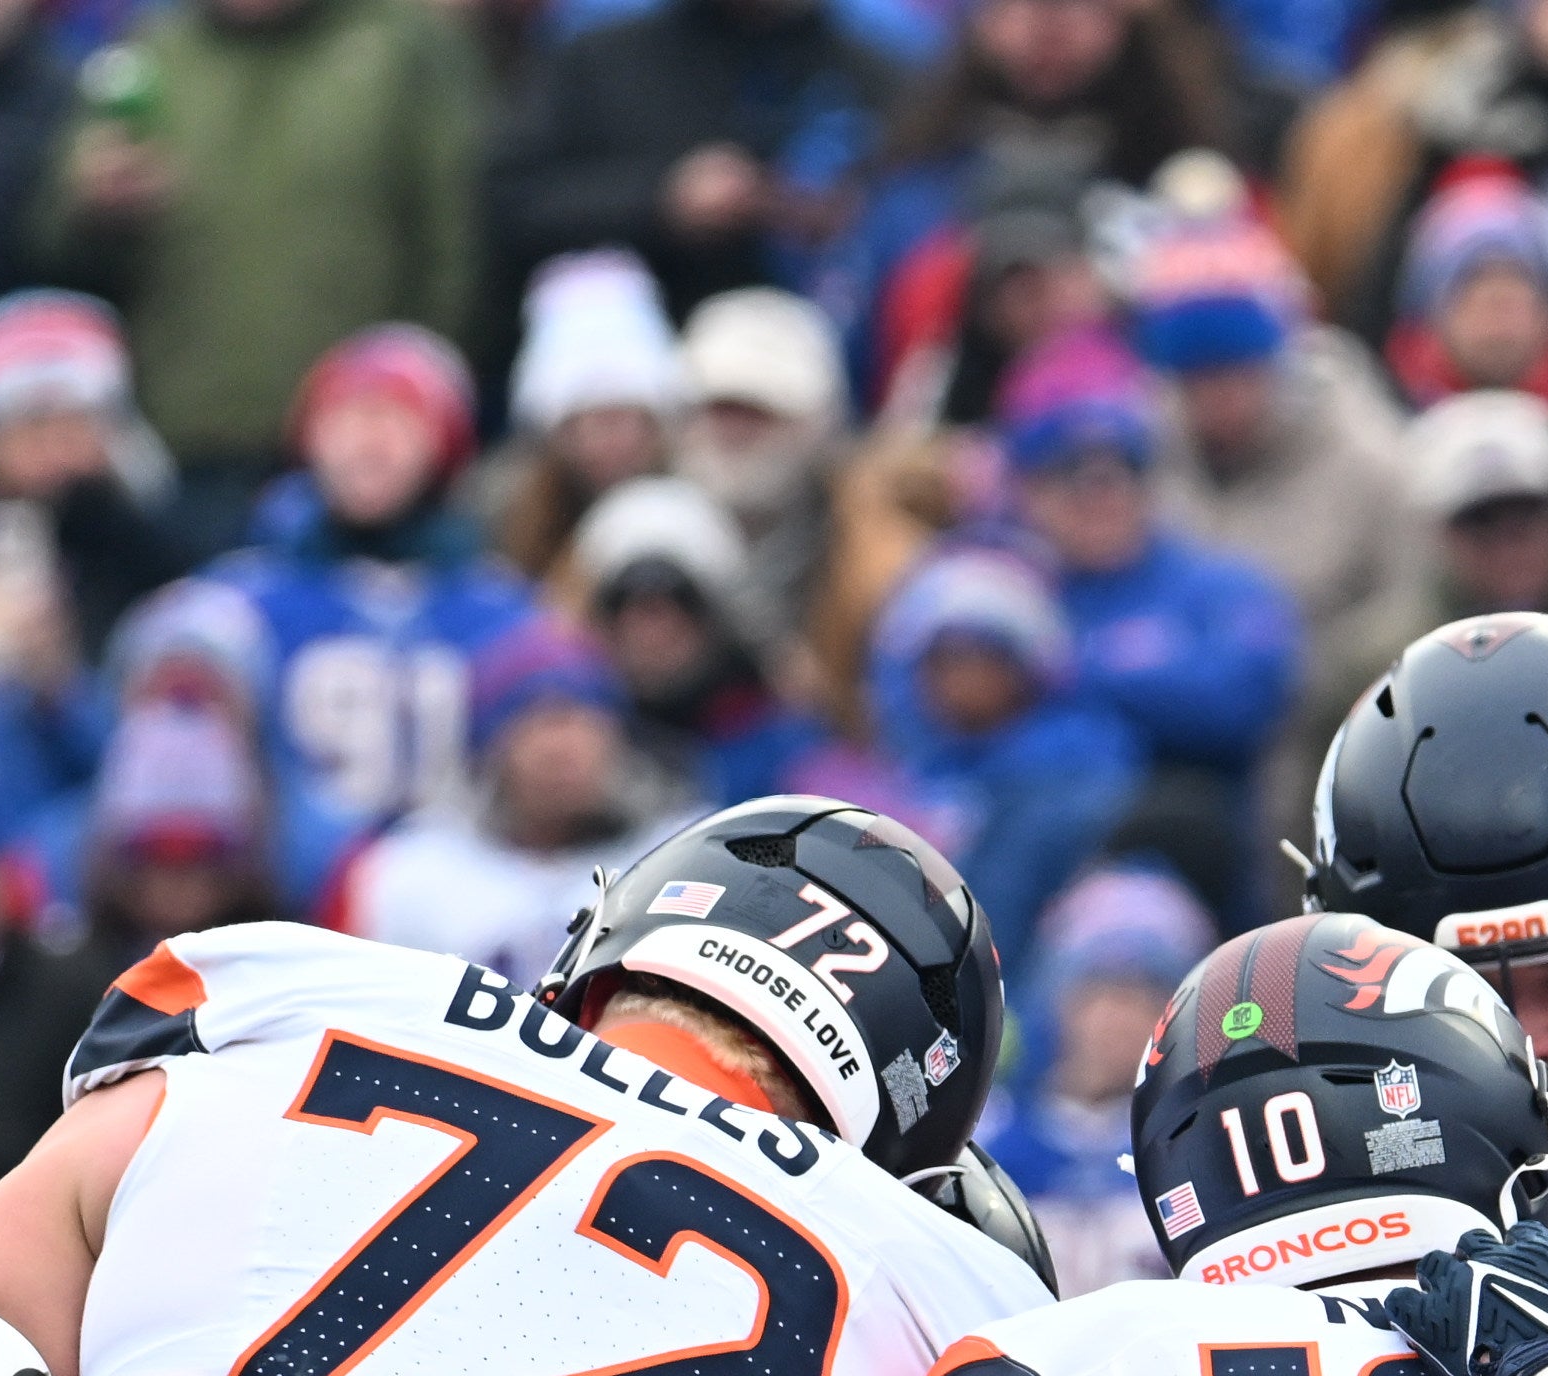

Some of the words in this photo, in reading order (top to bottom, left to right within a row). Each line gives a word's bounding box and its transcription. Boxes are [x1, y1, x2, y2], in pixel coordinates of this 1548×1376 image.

[767, 882, 889, 1005] 72
[698, 939, 806, 1012] CHOOSE
[803, 1008, 860, 1080] LOVE
[1220, 1091, 1326, 1197] 10
[1202, 1212, 1411, 1285] BRONCOS
